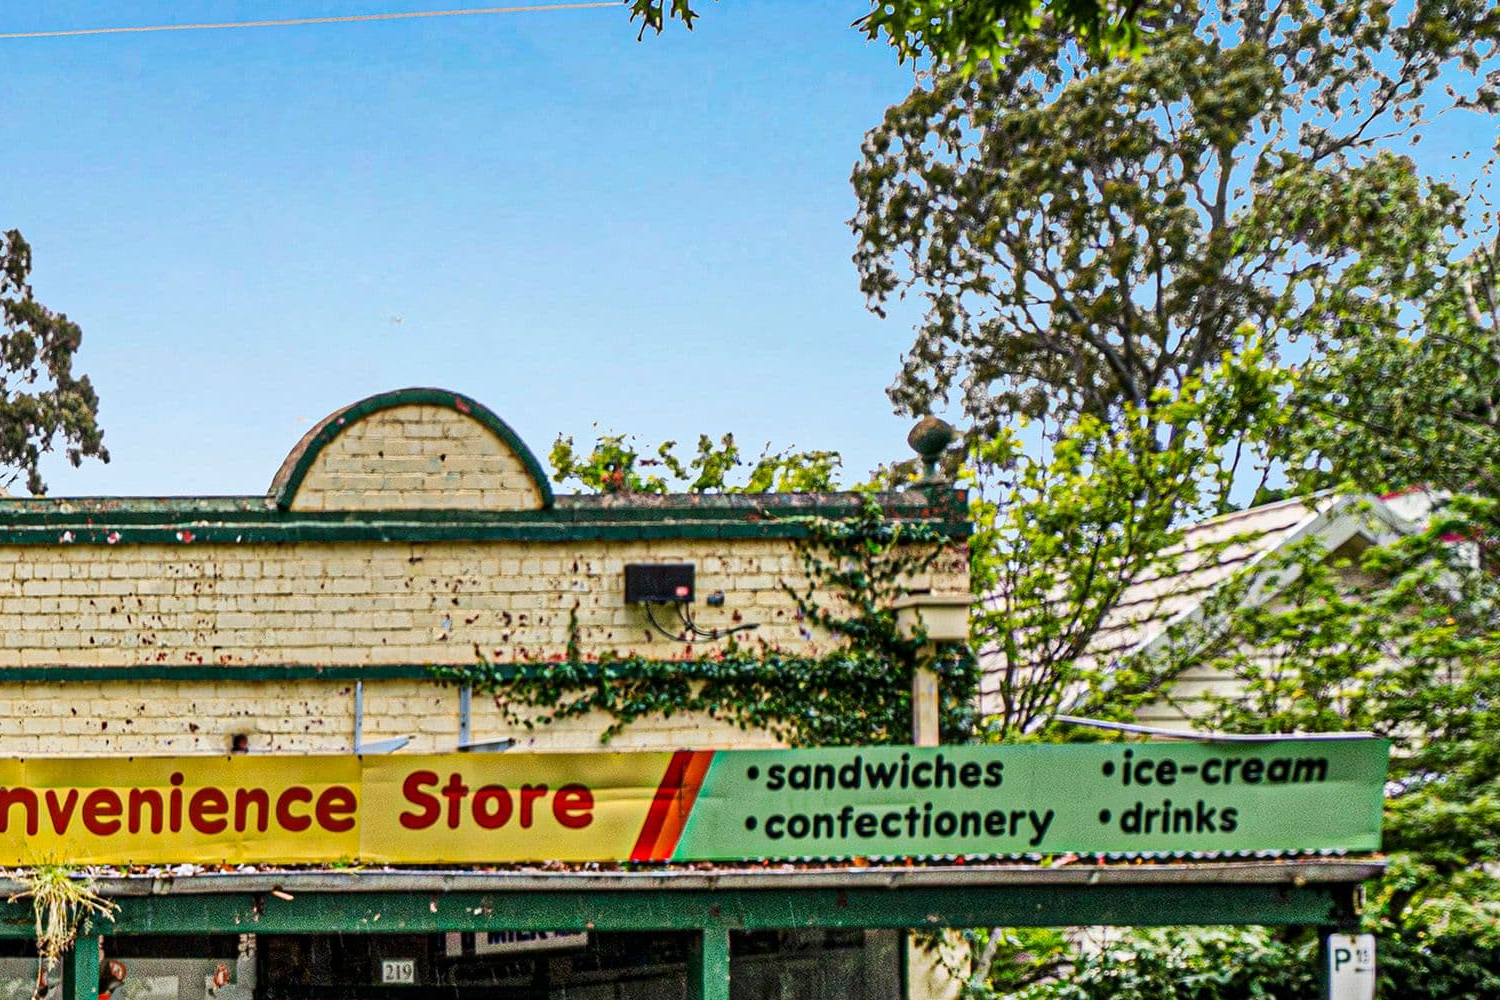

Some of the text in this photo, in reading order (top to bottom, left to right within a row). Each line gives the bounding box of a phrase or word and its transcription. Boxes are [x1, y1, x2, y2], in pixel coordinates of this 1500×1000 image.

[765, 752, 1004, 791] sandwiches
[1122, 749, 1330, 786] ice-cream
[399, 770, 595, 830] Store
[1119, 799, 1238, 834] drinks
[764, 802, 1055, 847] confectionery
[385, 964, 413, 981] 219
[1334, 948, 1352, 972] P
